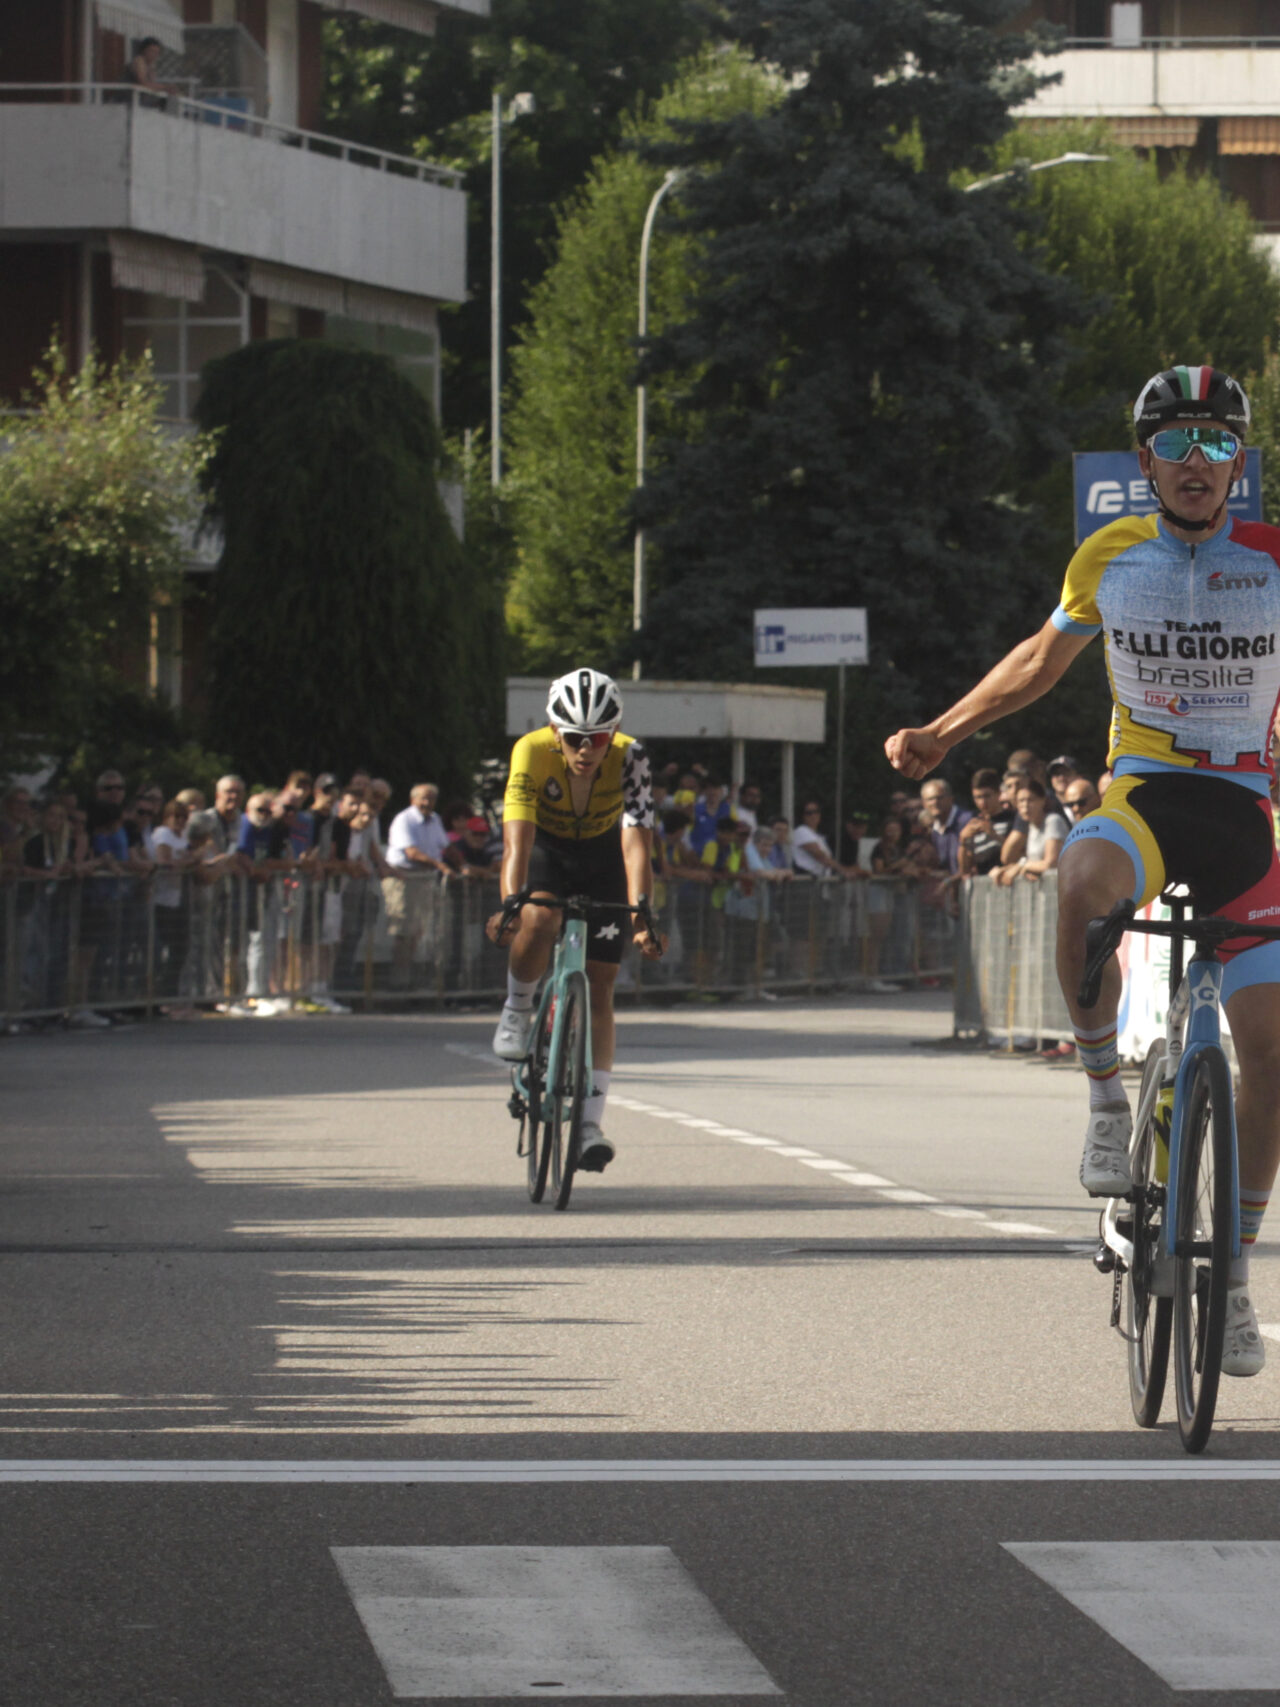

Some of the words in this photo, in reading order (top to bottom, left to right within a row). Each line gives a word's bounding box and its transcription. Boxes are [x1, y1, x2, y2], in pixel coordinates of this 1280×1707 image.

[1163, 619, 1222, 634] TEAM
[1176, 633, 1275, 660] GIORGI
[1137, 659, 1254, 688] brasilia
[1191, 695, 1245, 705] SERVICE
